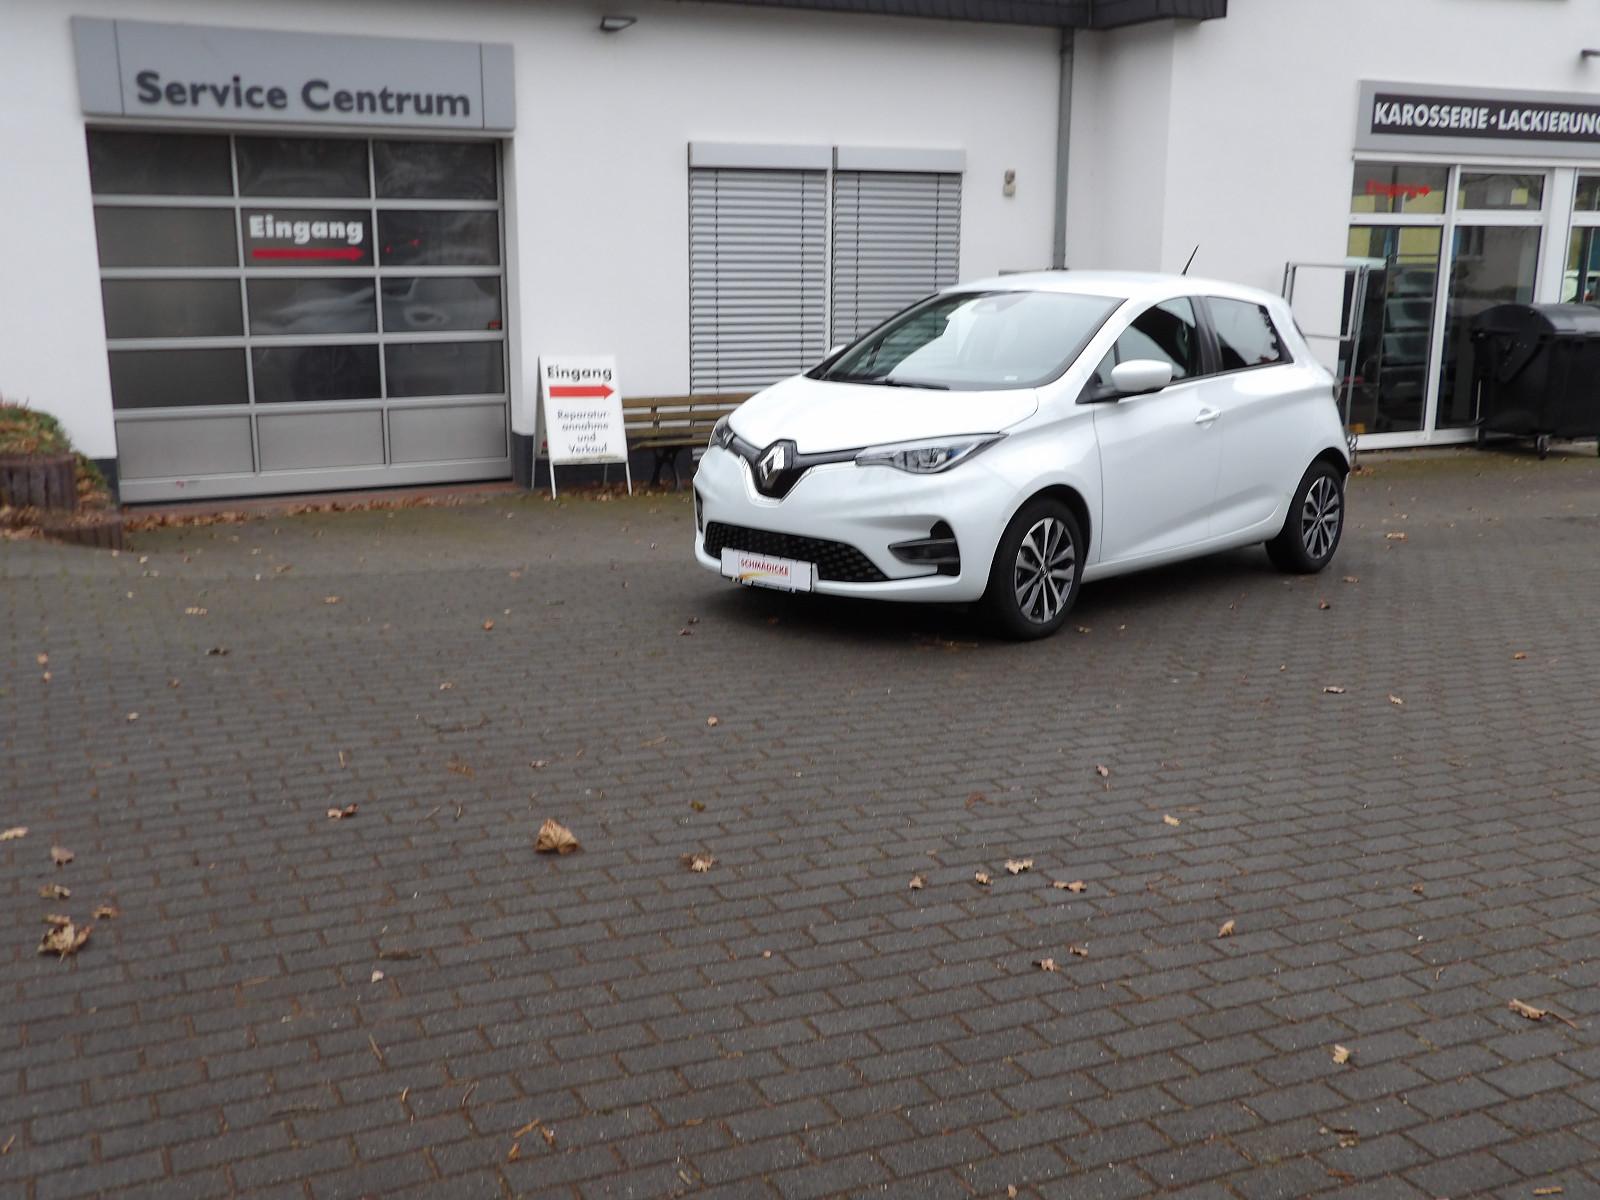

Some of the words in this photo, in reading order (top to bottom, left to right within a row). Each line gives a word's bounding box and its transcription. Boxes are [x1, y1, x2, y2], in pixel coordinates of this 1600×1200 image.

[136, 71, 288, 109] Service
[301, 79, 471, 117] Centrum
[249, 214, 364, 244] Eingang
[547, 364, 612, 381] Eingang
